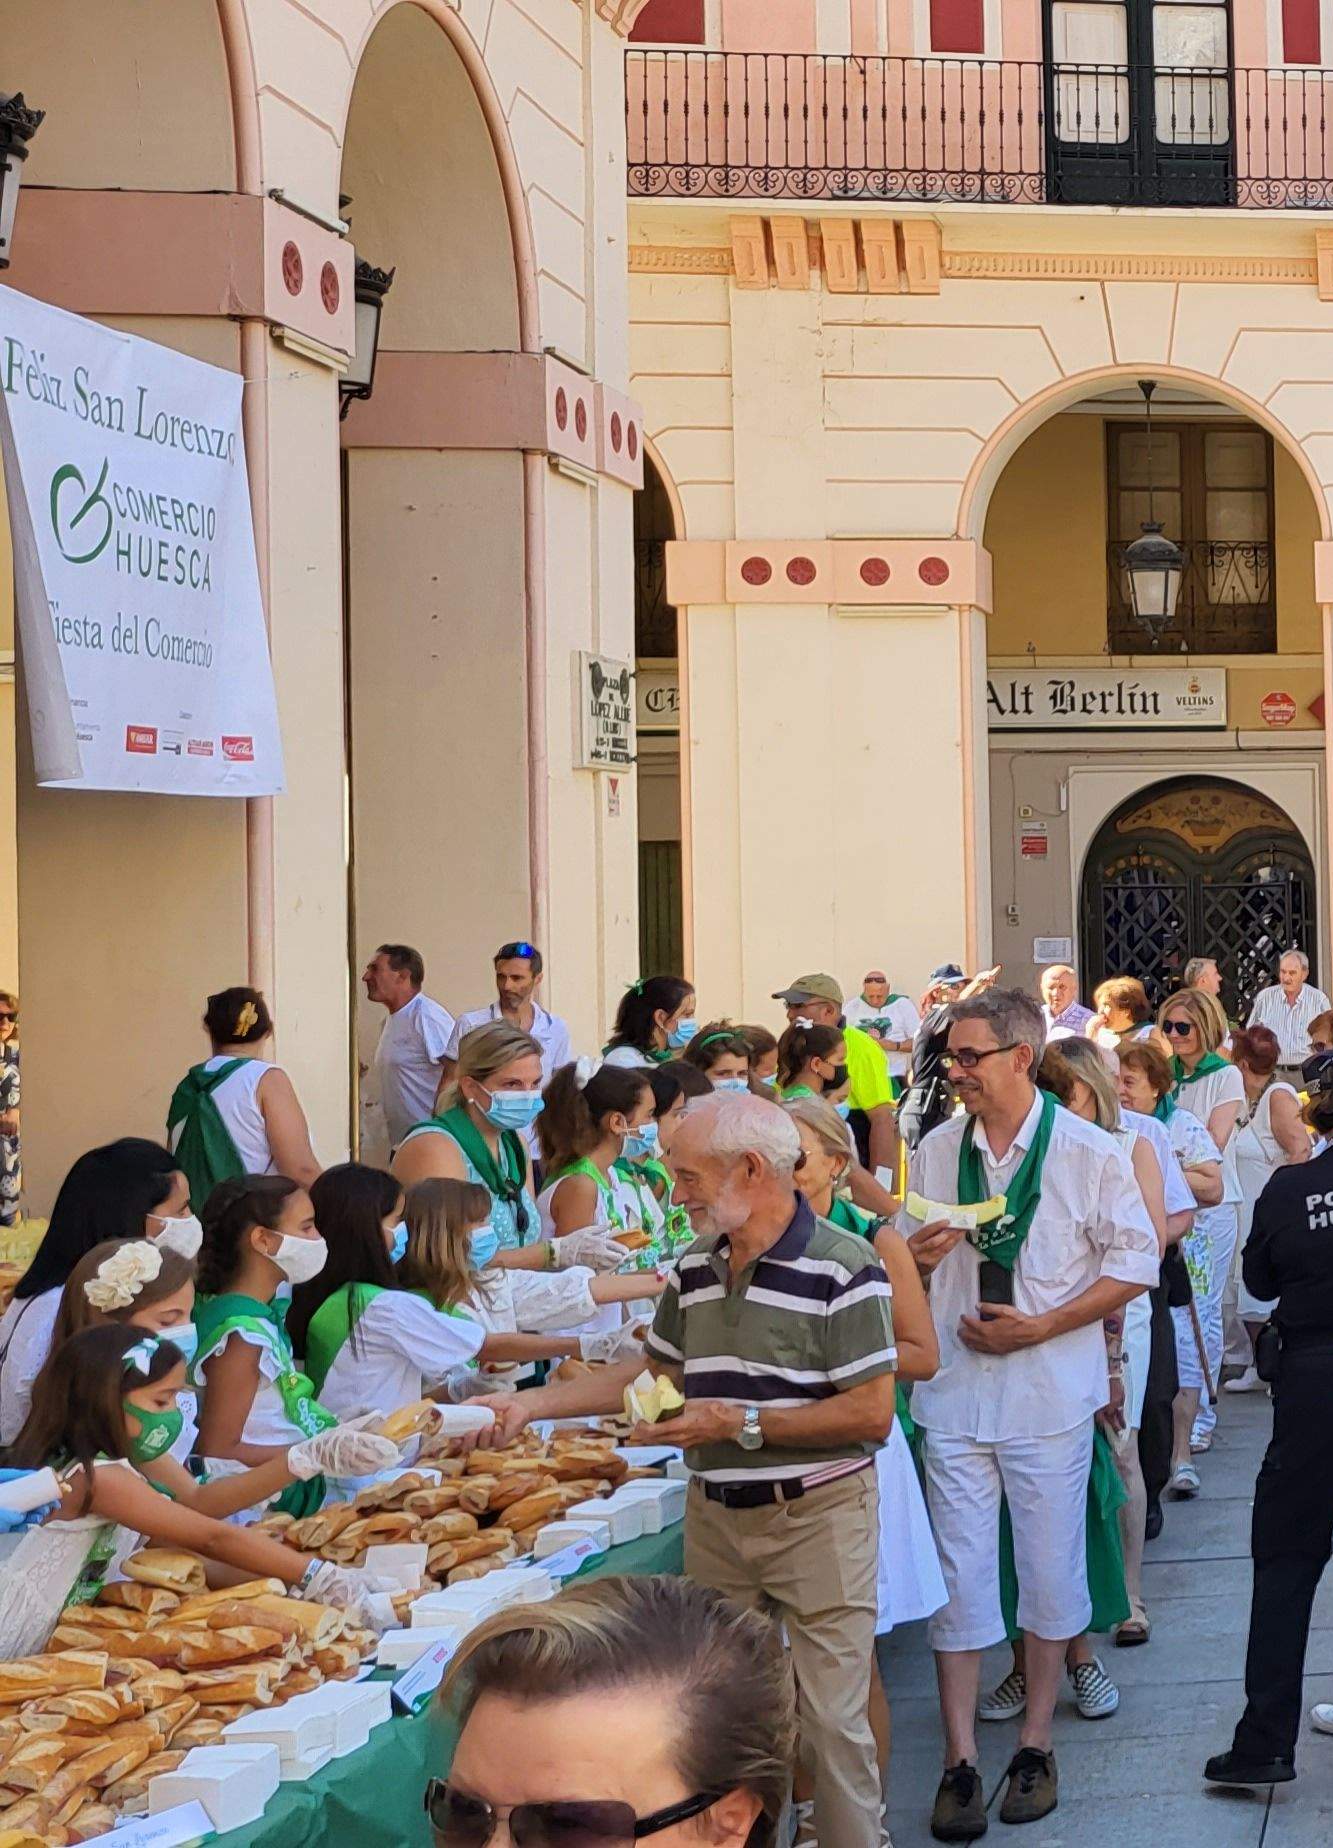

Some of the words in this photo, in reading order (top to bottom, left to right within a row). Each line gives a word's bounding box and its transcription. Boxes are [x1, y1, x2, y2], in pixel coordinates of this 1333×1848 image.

[74, 366, 125, 433] San
[112, 482, 216, 541] COMERCIO
[116, 530, 211, 593] HUESCA
[48, 601, 104, 651] iesta
[111, 611, 140, 655] del
[145, 617, 213, 668] Comercio
[987, 679, 1034, 716] Alt
[1176, 696, 1214, 706] VELTINS
